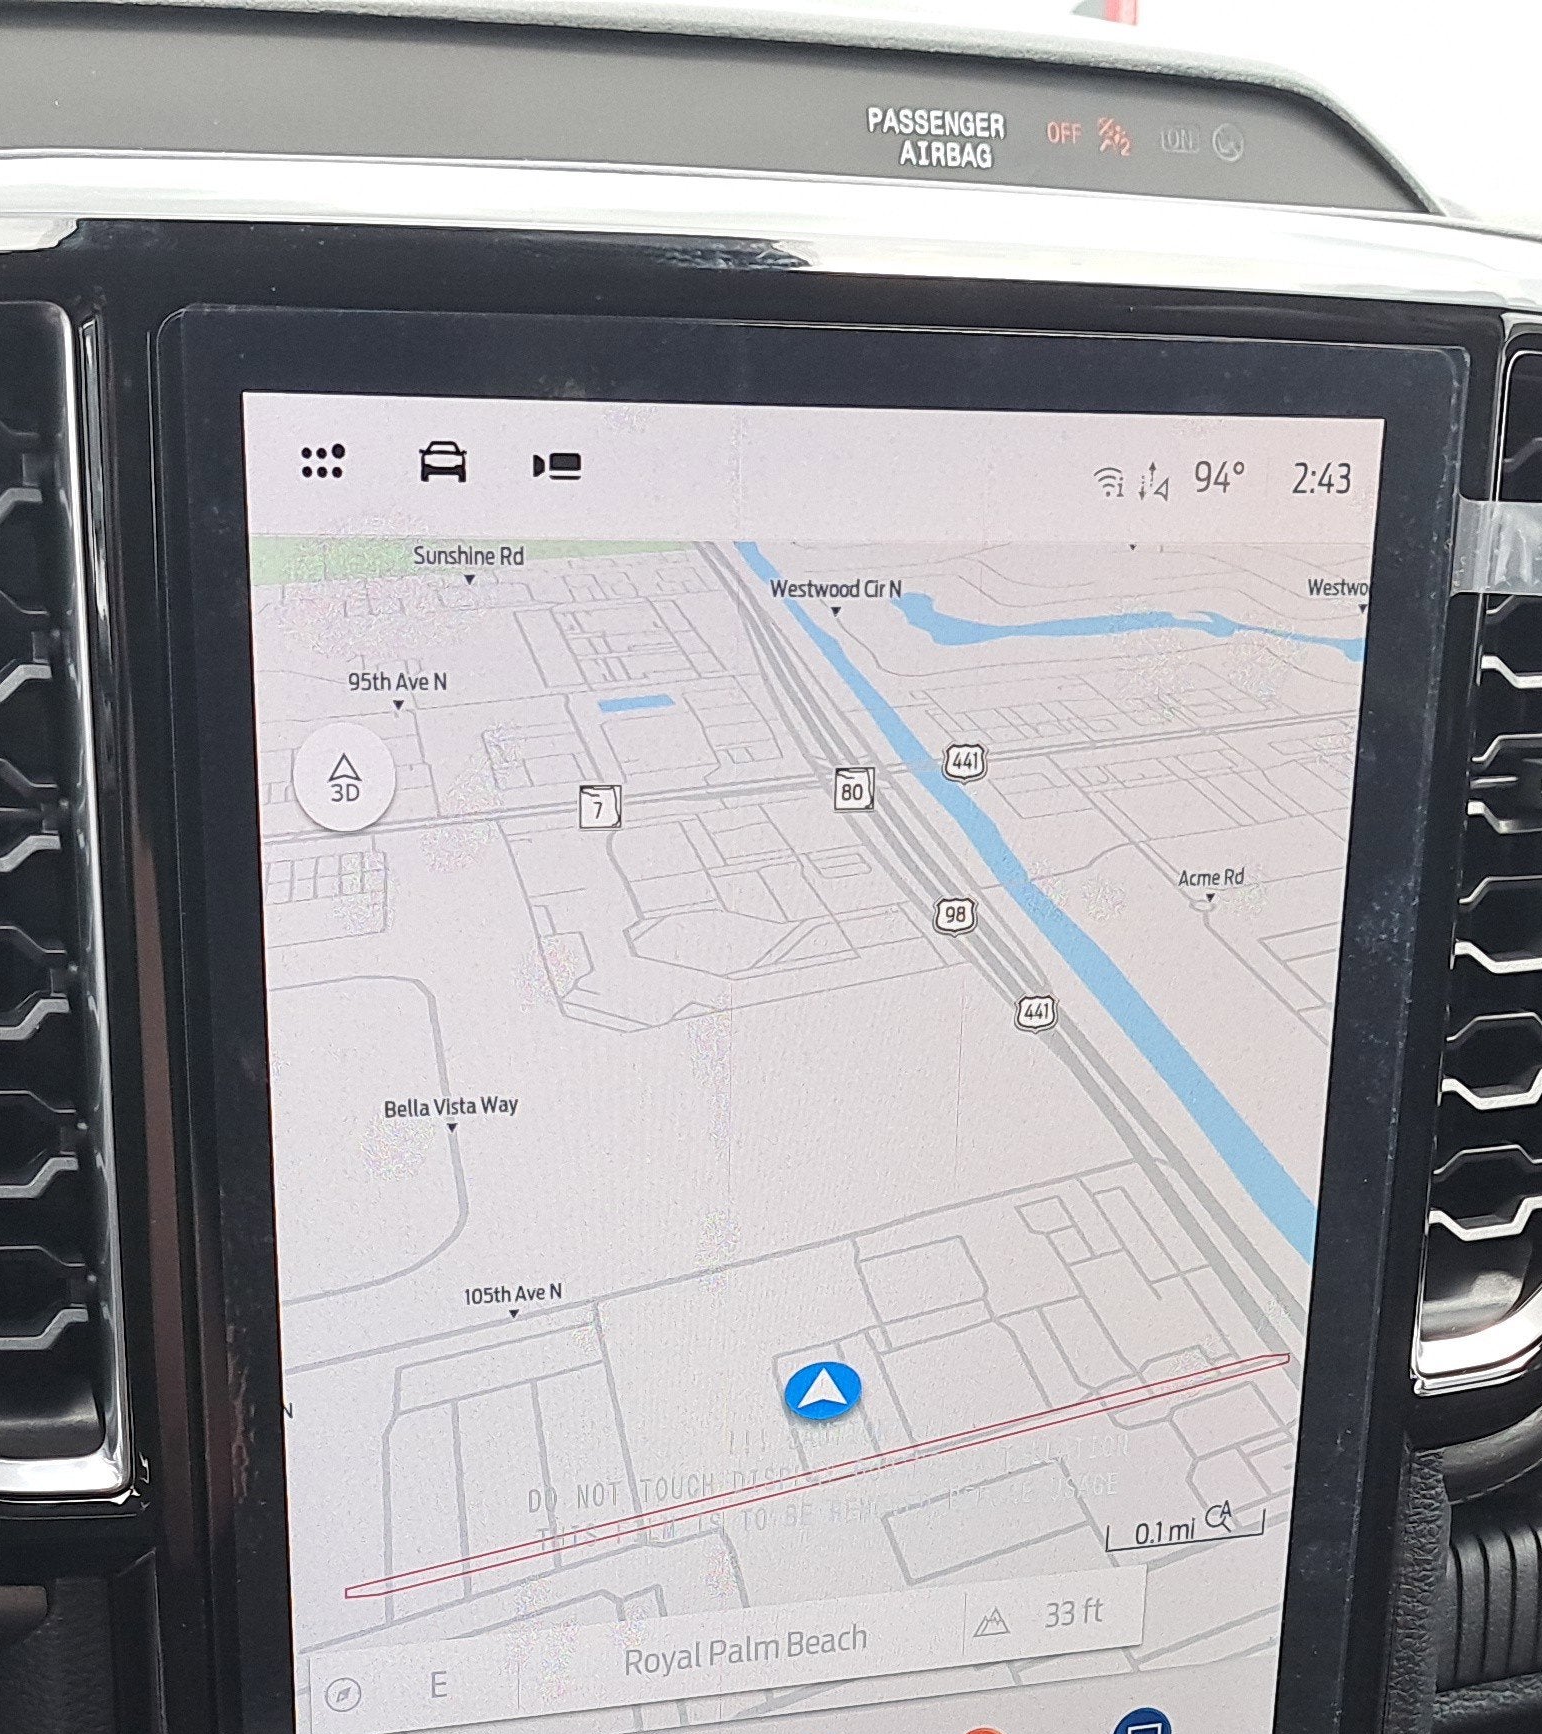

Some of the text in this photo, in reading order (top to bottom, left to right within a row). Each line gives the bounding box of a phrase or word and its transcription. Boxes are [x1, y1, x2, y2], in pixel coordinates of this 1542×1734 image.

[866, 106, 1005, 139] PASSENGER
[1047, 121, 1081, 145] OFF
[899, 139, 992, 169] AIRBAG
[1291, 461, 1352, 495] 2:43
[413, 545, 525, 567] Sunshine Rd
[771, 580, 902, 599] Westwood Cir N
[1308, 580, 1369, 597] Westwo
[348, 673, 447, 692] 95th Ave N
[952, 751, 979, 771] 441
[330, 784, 361, 802] 3D
[841, 783, 864, 802] 80
[592, 801, 603, 820] 7
[1178, 868, 1245, 888] Acme Rd
[944, 906, 967, 923] 98
[1023, 1003, 1050, 1021] 441
[384, 1096, 519, 1118] Bella Vista Way
[464, 1284, 562, 1305] 105th Ave N
[1135, 1518, 1195, 1546] 0.1 mi
[1045, 1598, 1104, 1628] 33 ft
[624, 1624, 868, 1677] Royal Palm Beach
[430, 1671, 448, 1698] E
